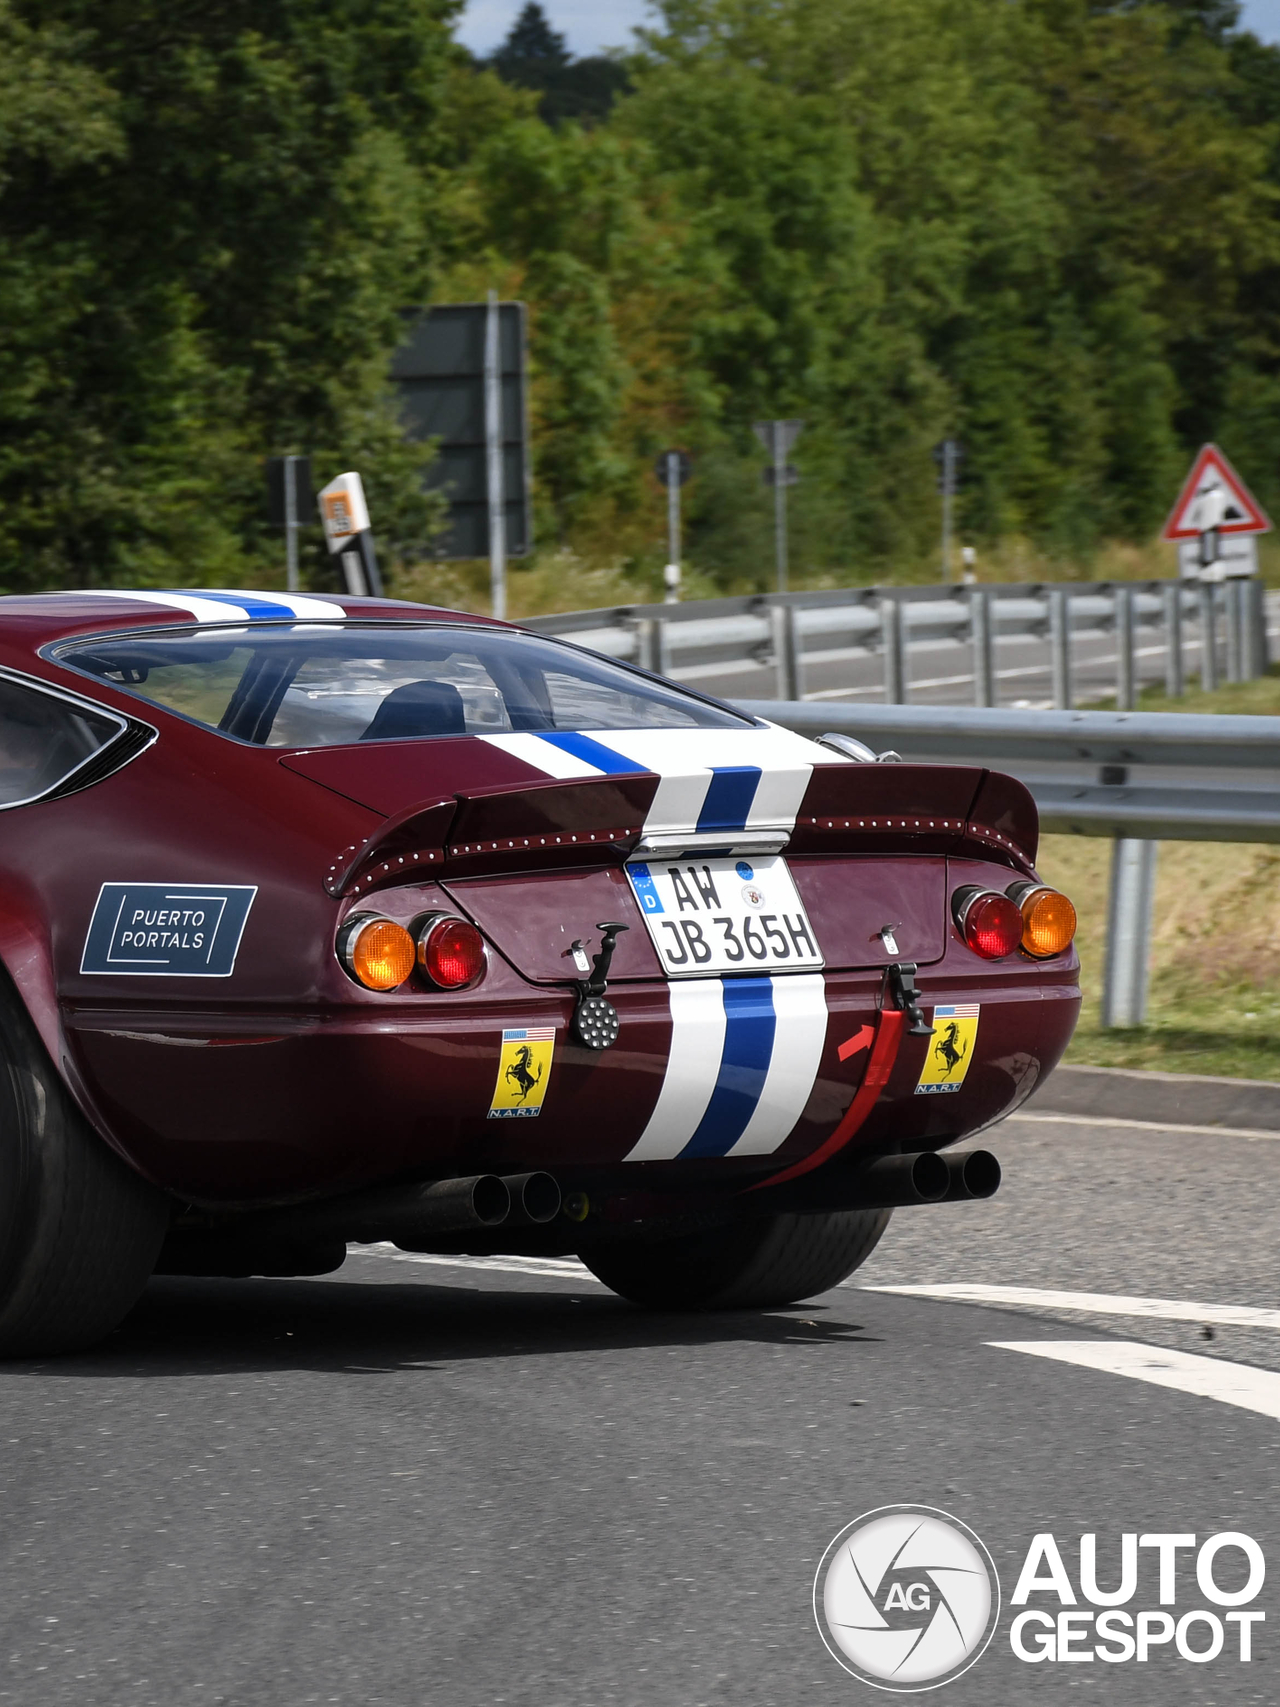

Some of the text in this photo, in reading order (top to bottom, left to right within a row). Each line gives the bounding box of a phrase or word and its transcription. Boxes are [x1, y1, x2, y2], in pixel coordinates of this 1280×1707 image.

[667, 865, 722, 911] AW
[644, 894, 657, 909] D
[131, 909, 205, 927] PUERTO
[120, 931, 205, 949] PORTALS
[661, 914, 817, 964] JB 365H
[916, 1083, 960, 1093] N.A.R.T.
[489, 1107, 538, 1118] N.A.R.T.
